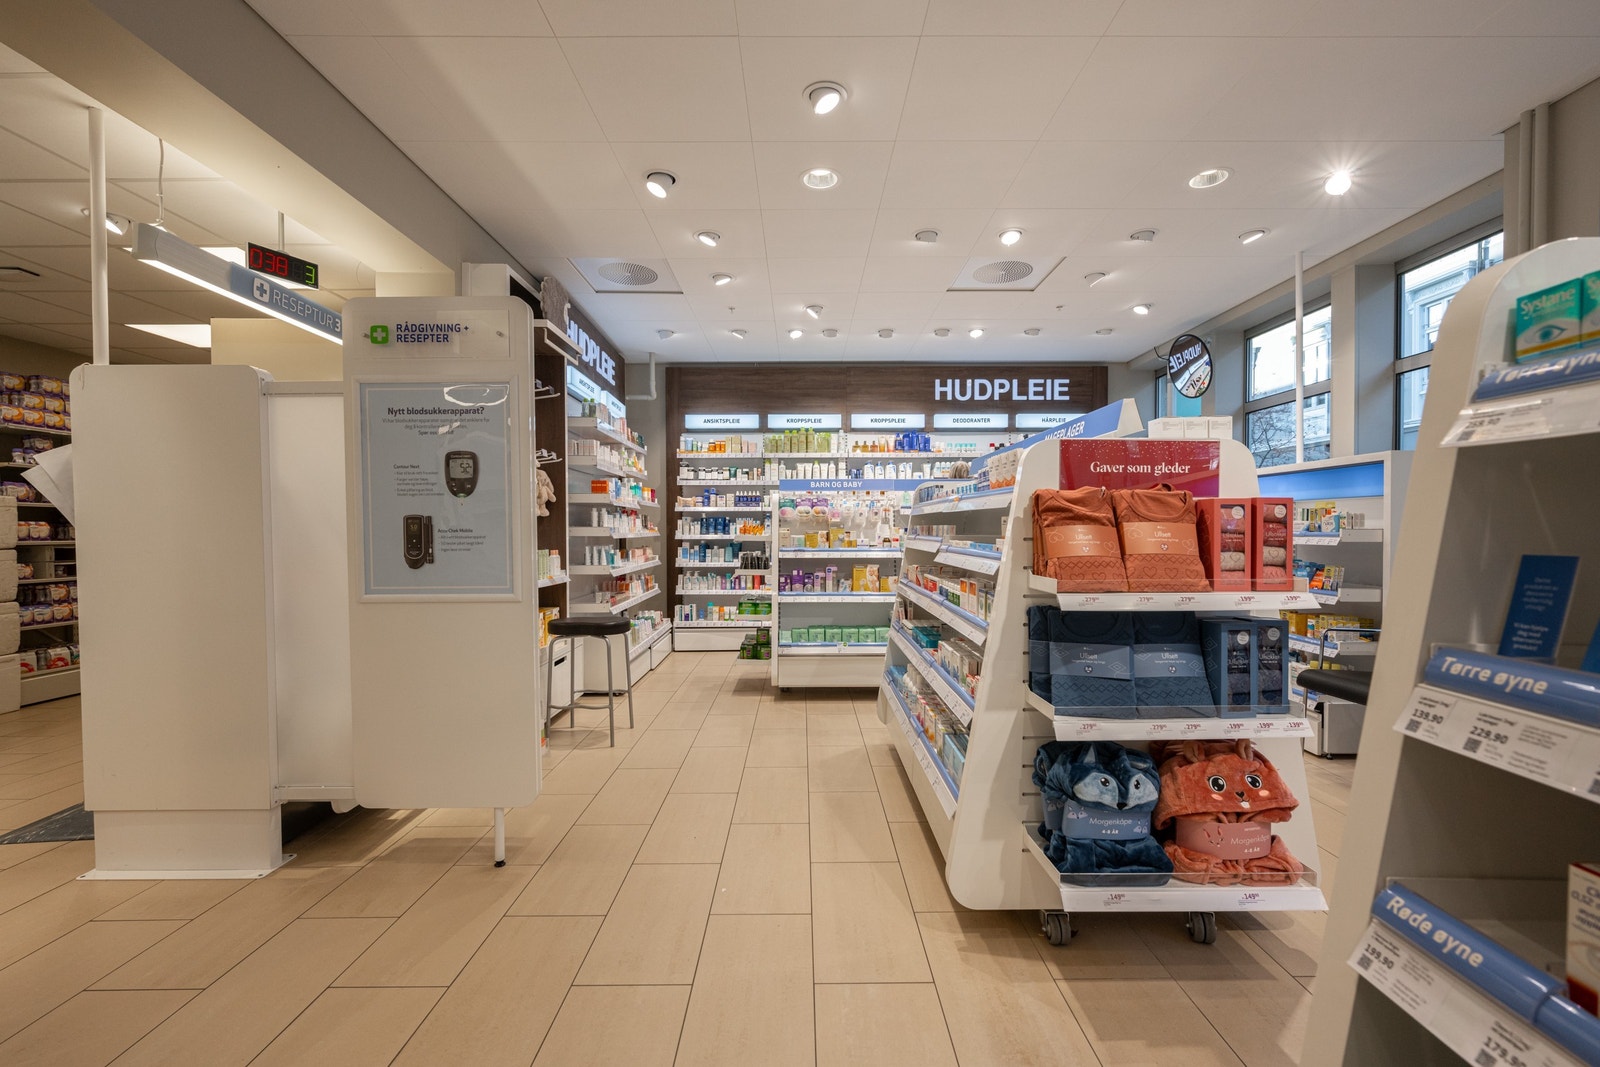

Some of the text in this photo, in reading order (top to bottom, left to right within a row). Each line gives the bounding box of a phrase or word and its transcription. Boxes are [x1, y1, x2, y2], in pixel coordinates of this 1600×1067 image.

[250, 248, 315, 284] 038 3
[272, 289, 341, 332] RESEPTUR 3
[396, 321, 461, 333] RÅDGIVNING
[396, 334, 450, 342] RESEPTER
[934, 378, 1070, 400] HUDPLEIE
[388, 406, 484, 417] Nytt blodsukkerapparat?
[1090, 462, 1190, 476] Gaver som gleder
[1440, 656, 1549, 695] Tørre øyne
[1089, 818, 1132, 826] Morgenkåpe
[1230, 834, 1269, 845] Morgenkåpe
[1386, 895, 1433, 934] Røde
[1432, 928, 1484, 968] øyne
